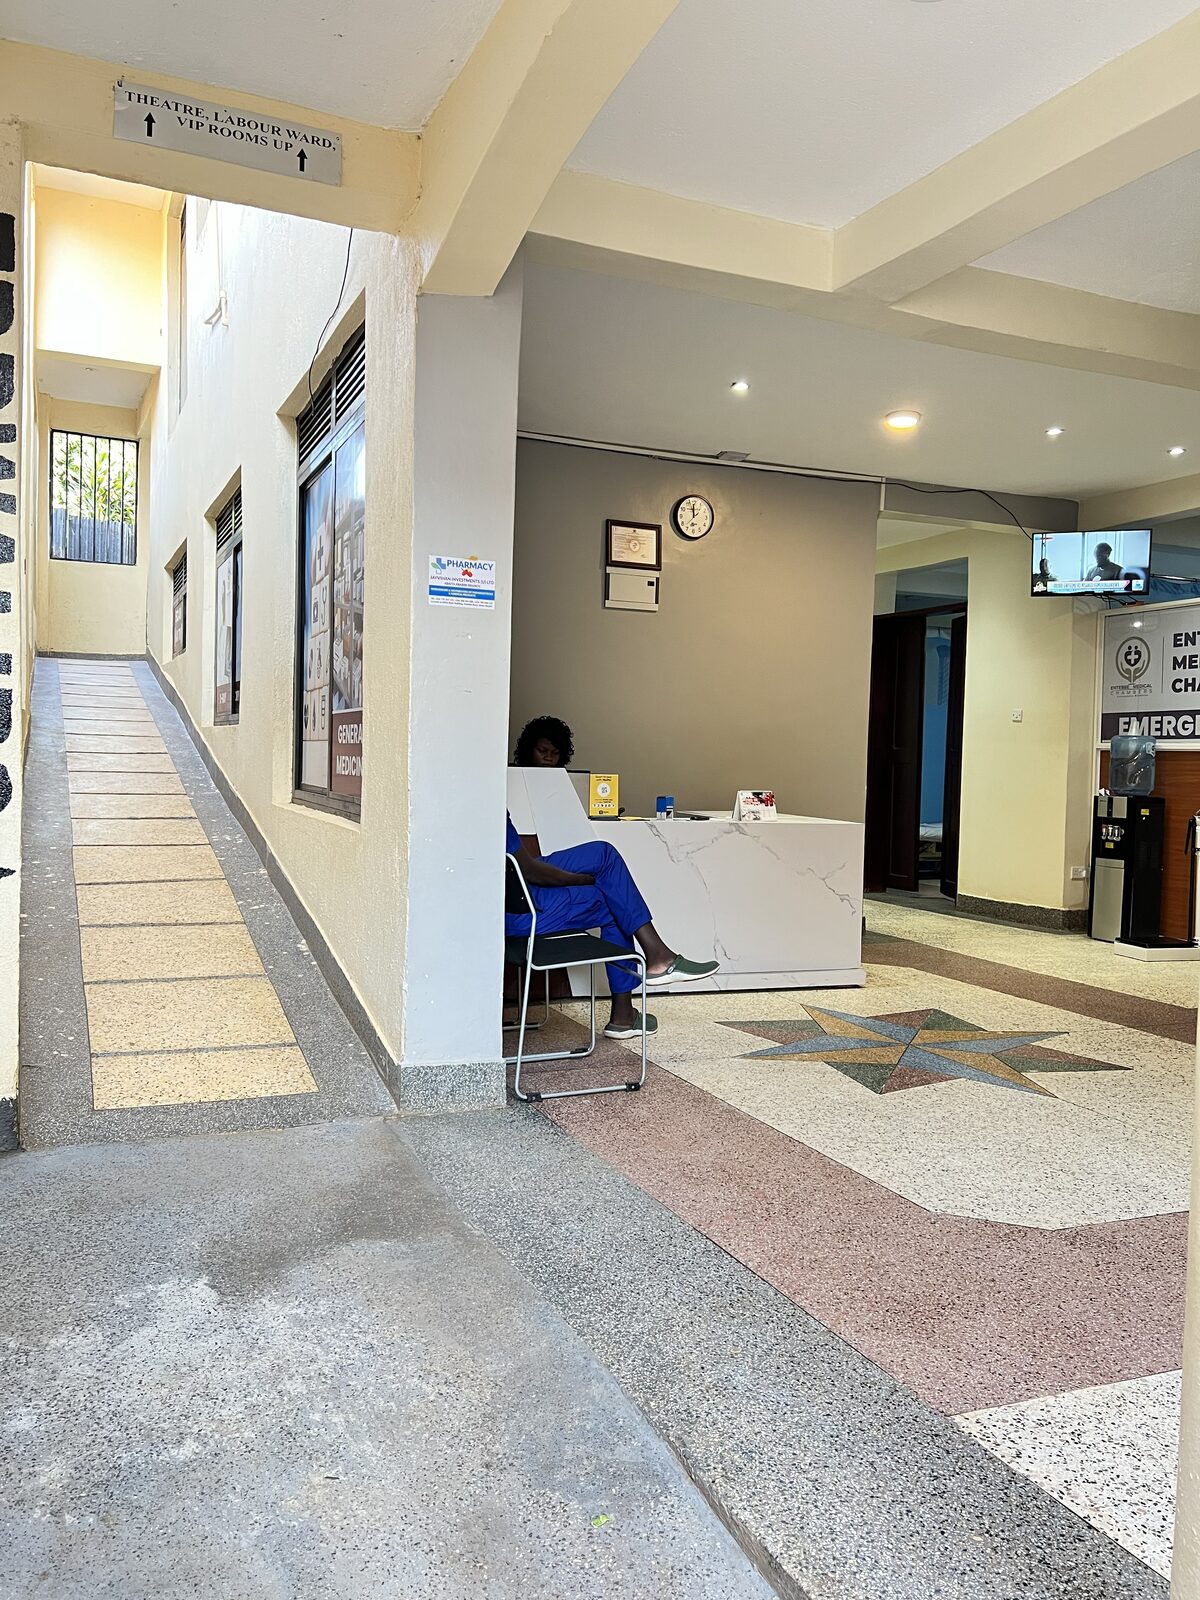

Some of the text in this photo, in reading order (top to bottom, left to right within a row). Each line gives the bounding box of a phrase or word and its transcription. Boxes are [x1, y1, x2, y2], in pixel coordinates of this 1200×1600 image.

[125, 90, 336, 151] THEATRE, LABOUR WARD,
[177, 116, 294, 152] VIP ROOMS UP
[447, 559, 494, 571] PHARMACY
[1173, 631, 1200, 647] EN
